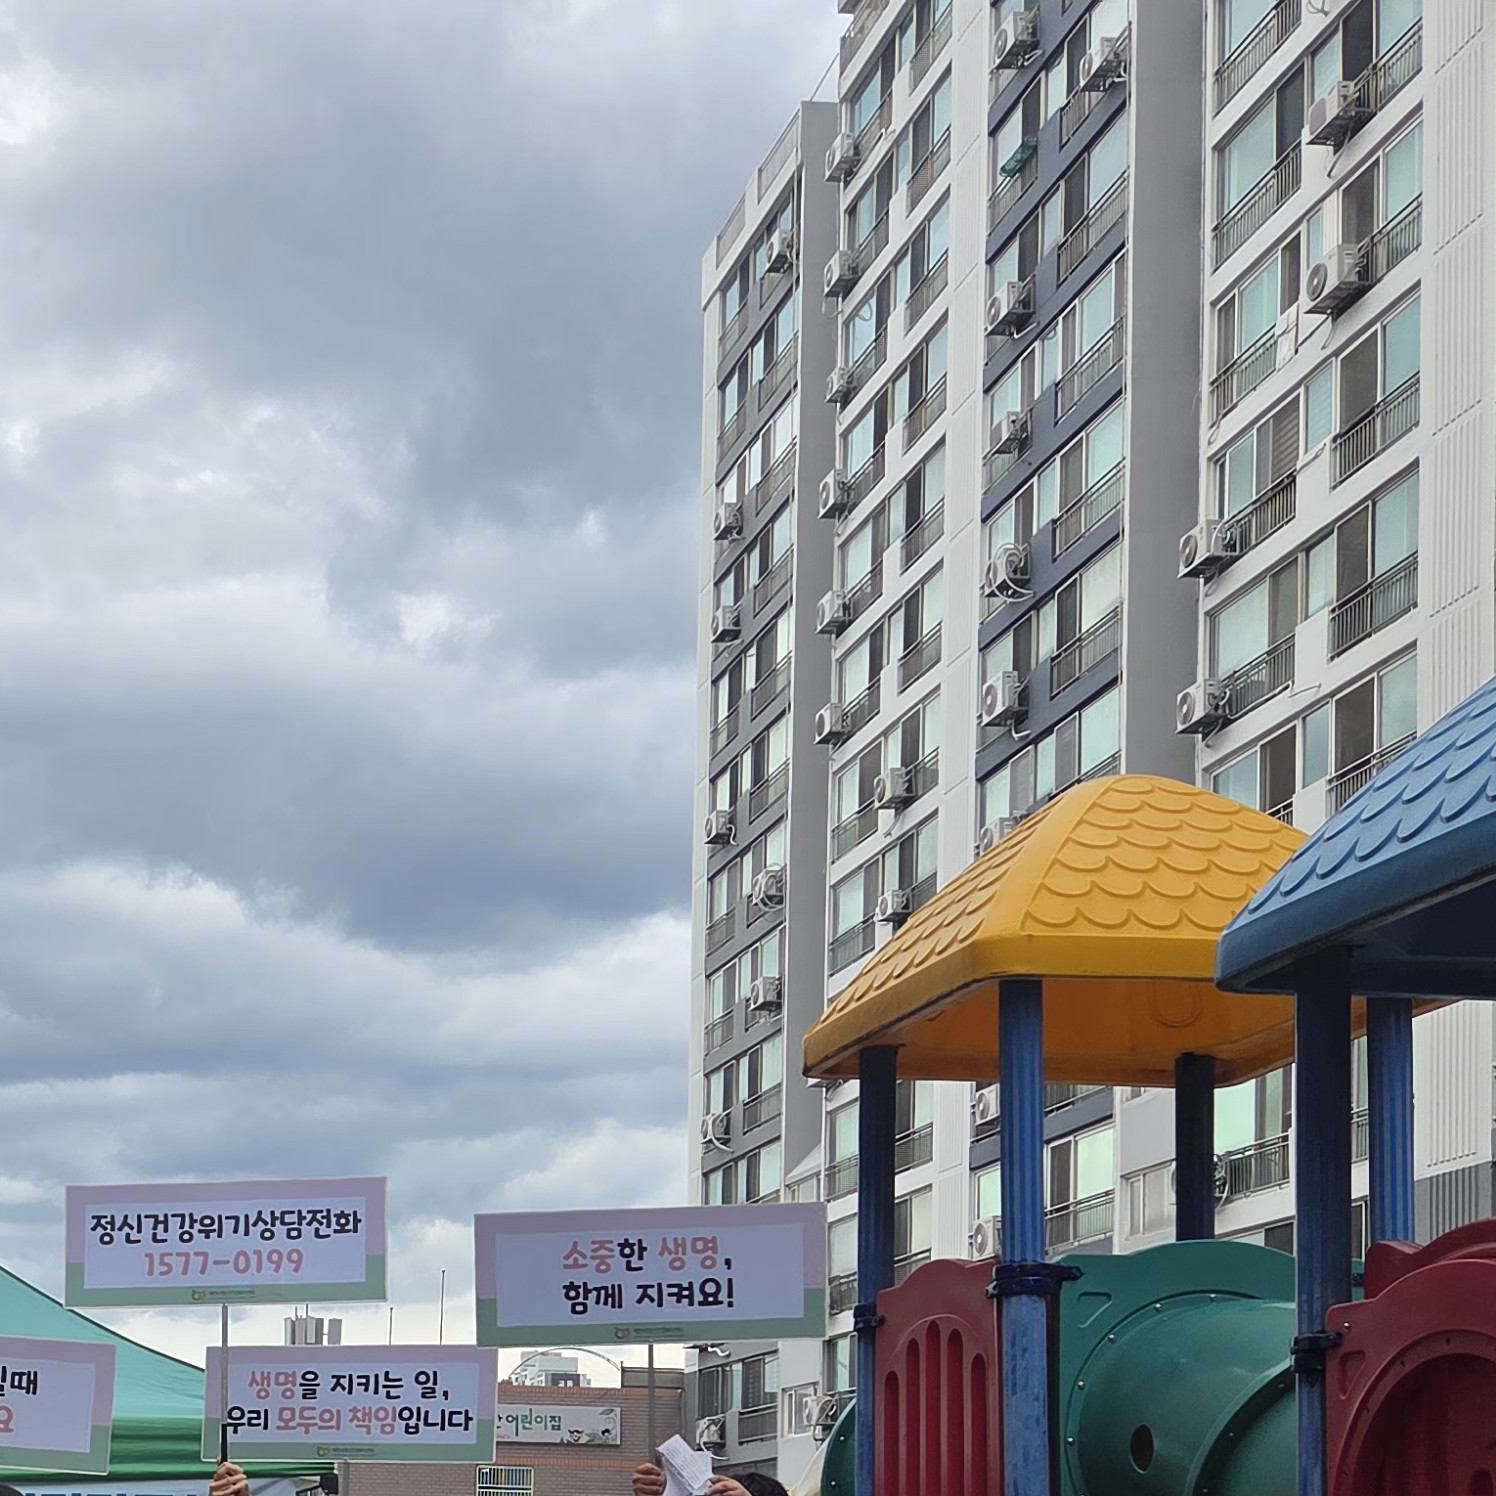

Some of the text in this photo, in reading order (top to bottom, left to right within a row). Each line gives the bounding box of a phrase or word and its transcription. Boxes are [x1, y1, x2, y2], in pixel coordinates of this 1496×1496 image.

[90, 1208, 362, 1245] 정신건강위기상담전화
[144, 1247, 304, 1278] 1577-0199
[562, 1235, 732, 1272] 소중한 생명,
[561, 1276, 734, 1312] 함께 지켜요!
[247, 1369, 450, 1402] 생명을 지키는 일,
[225, 1405, 269, 1433] 우리
[275, 1405, 342, 1432] 모두의
[349, 1405, 473, 1433] 책임입니다
